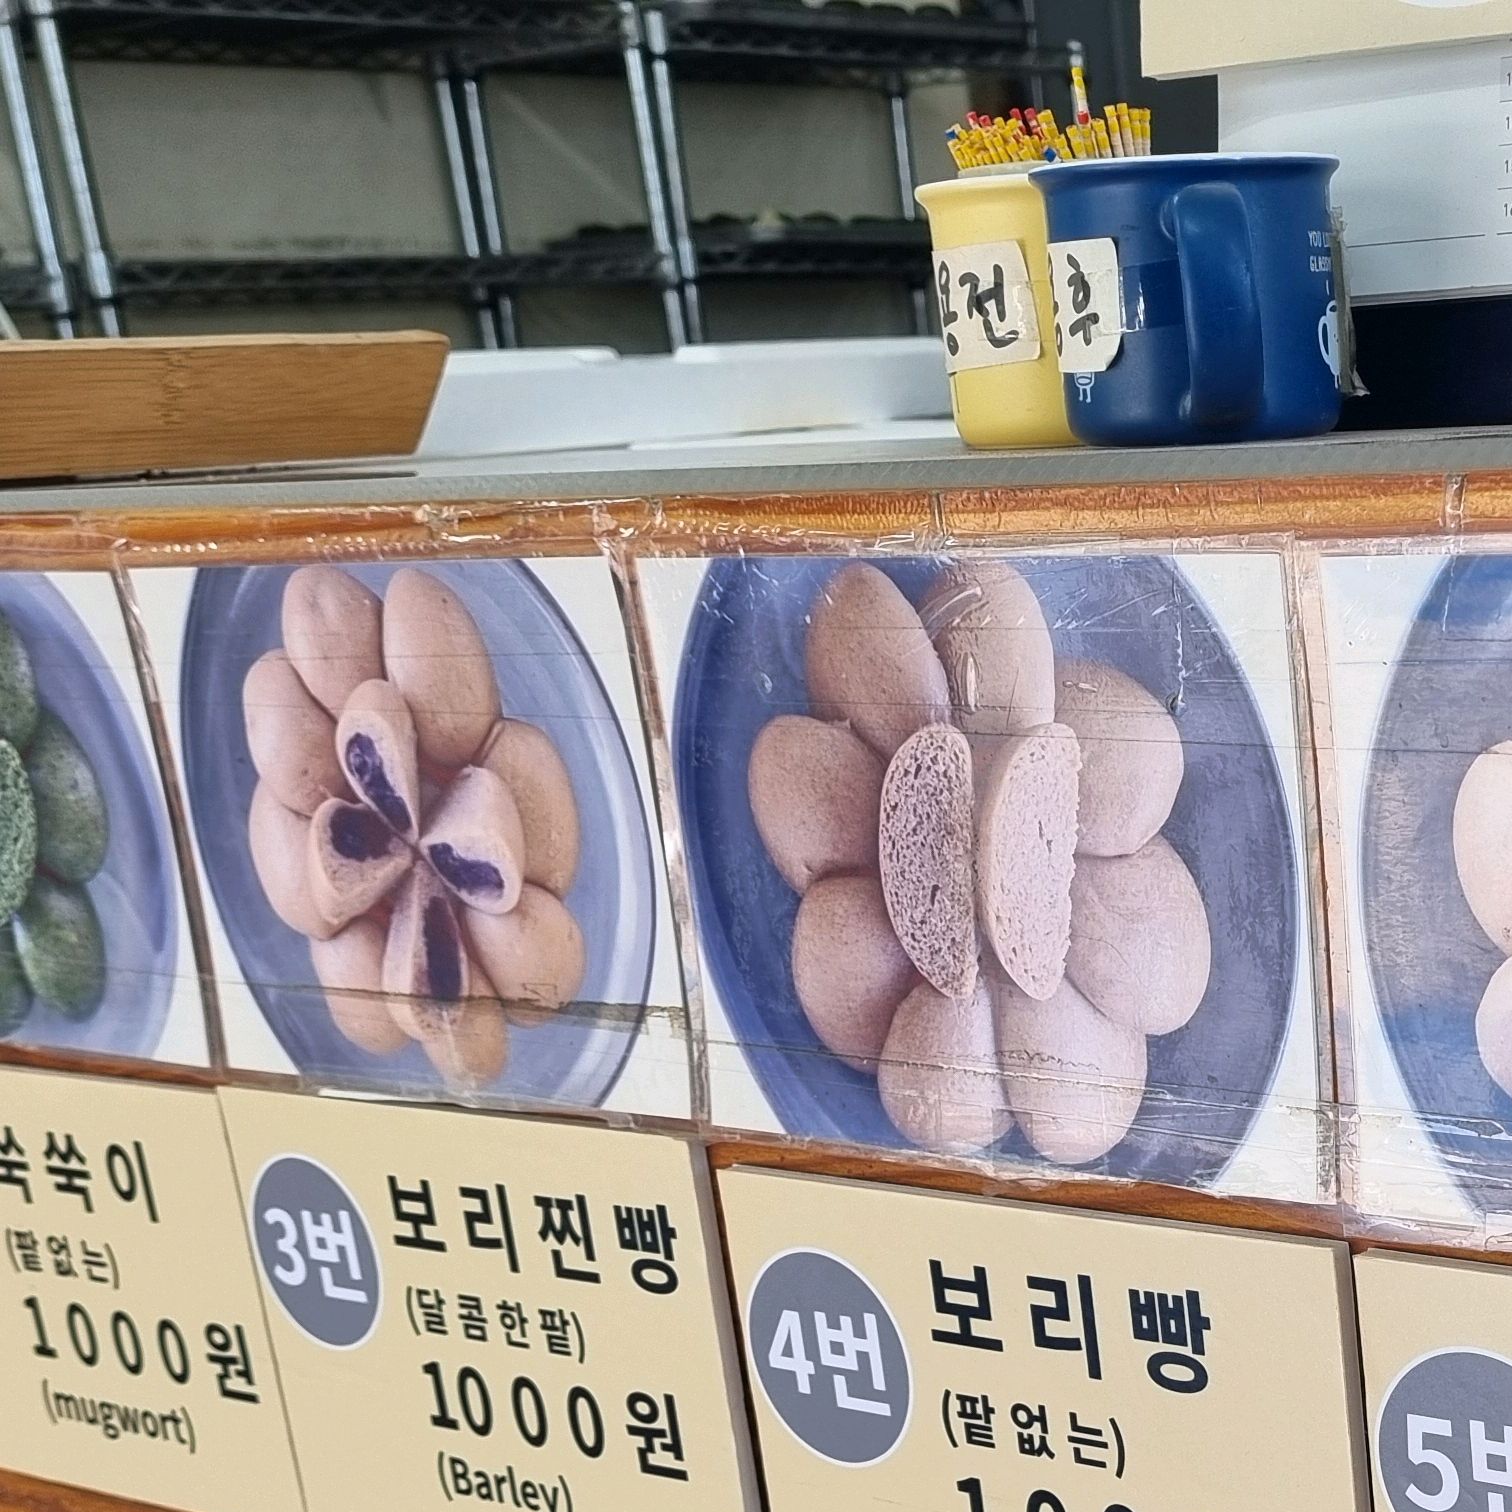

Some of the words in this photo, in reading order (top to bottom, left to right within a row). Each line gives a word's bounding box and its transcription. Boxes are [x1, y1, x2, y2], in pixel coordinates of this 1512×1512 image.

[262, 1206, 369, 1304] 3번
[386, 1175, 680, 1294] 보리찐빵
[767, 1309, 892, 1417] 4번
[42, 1378, 196, 1453] (mugwort)
